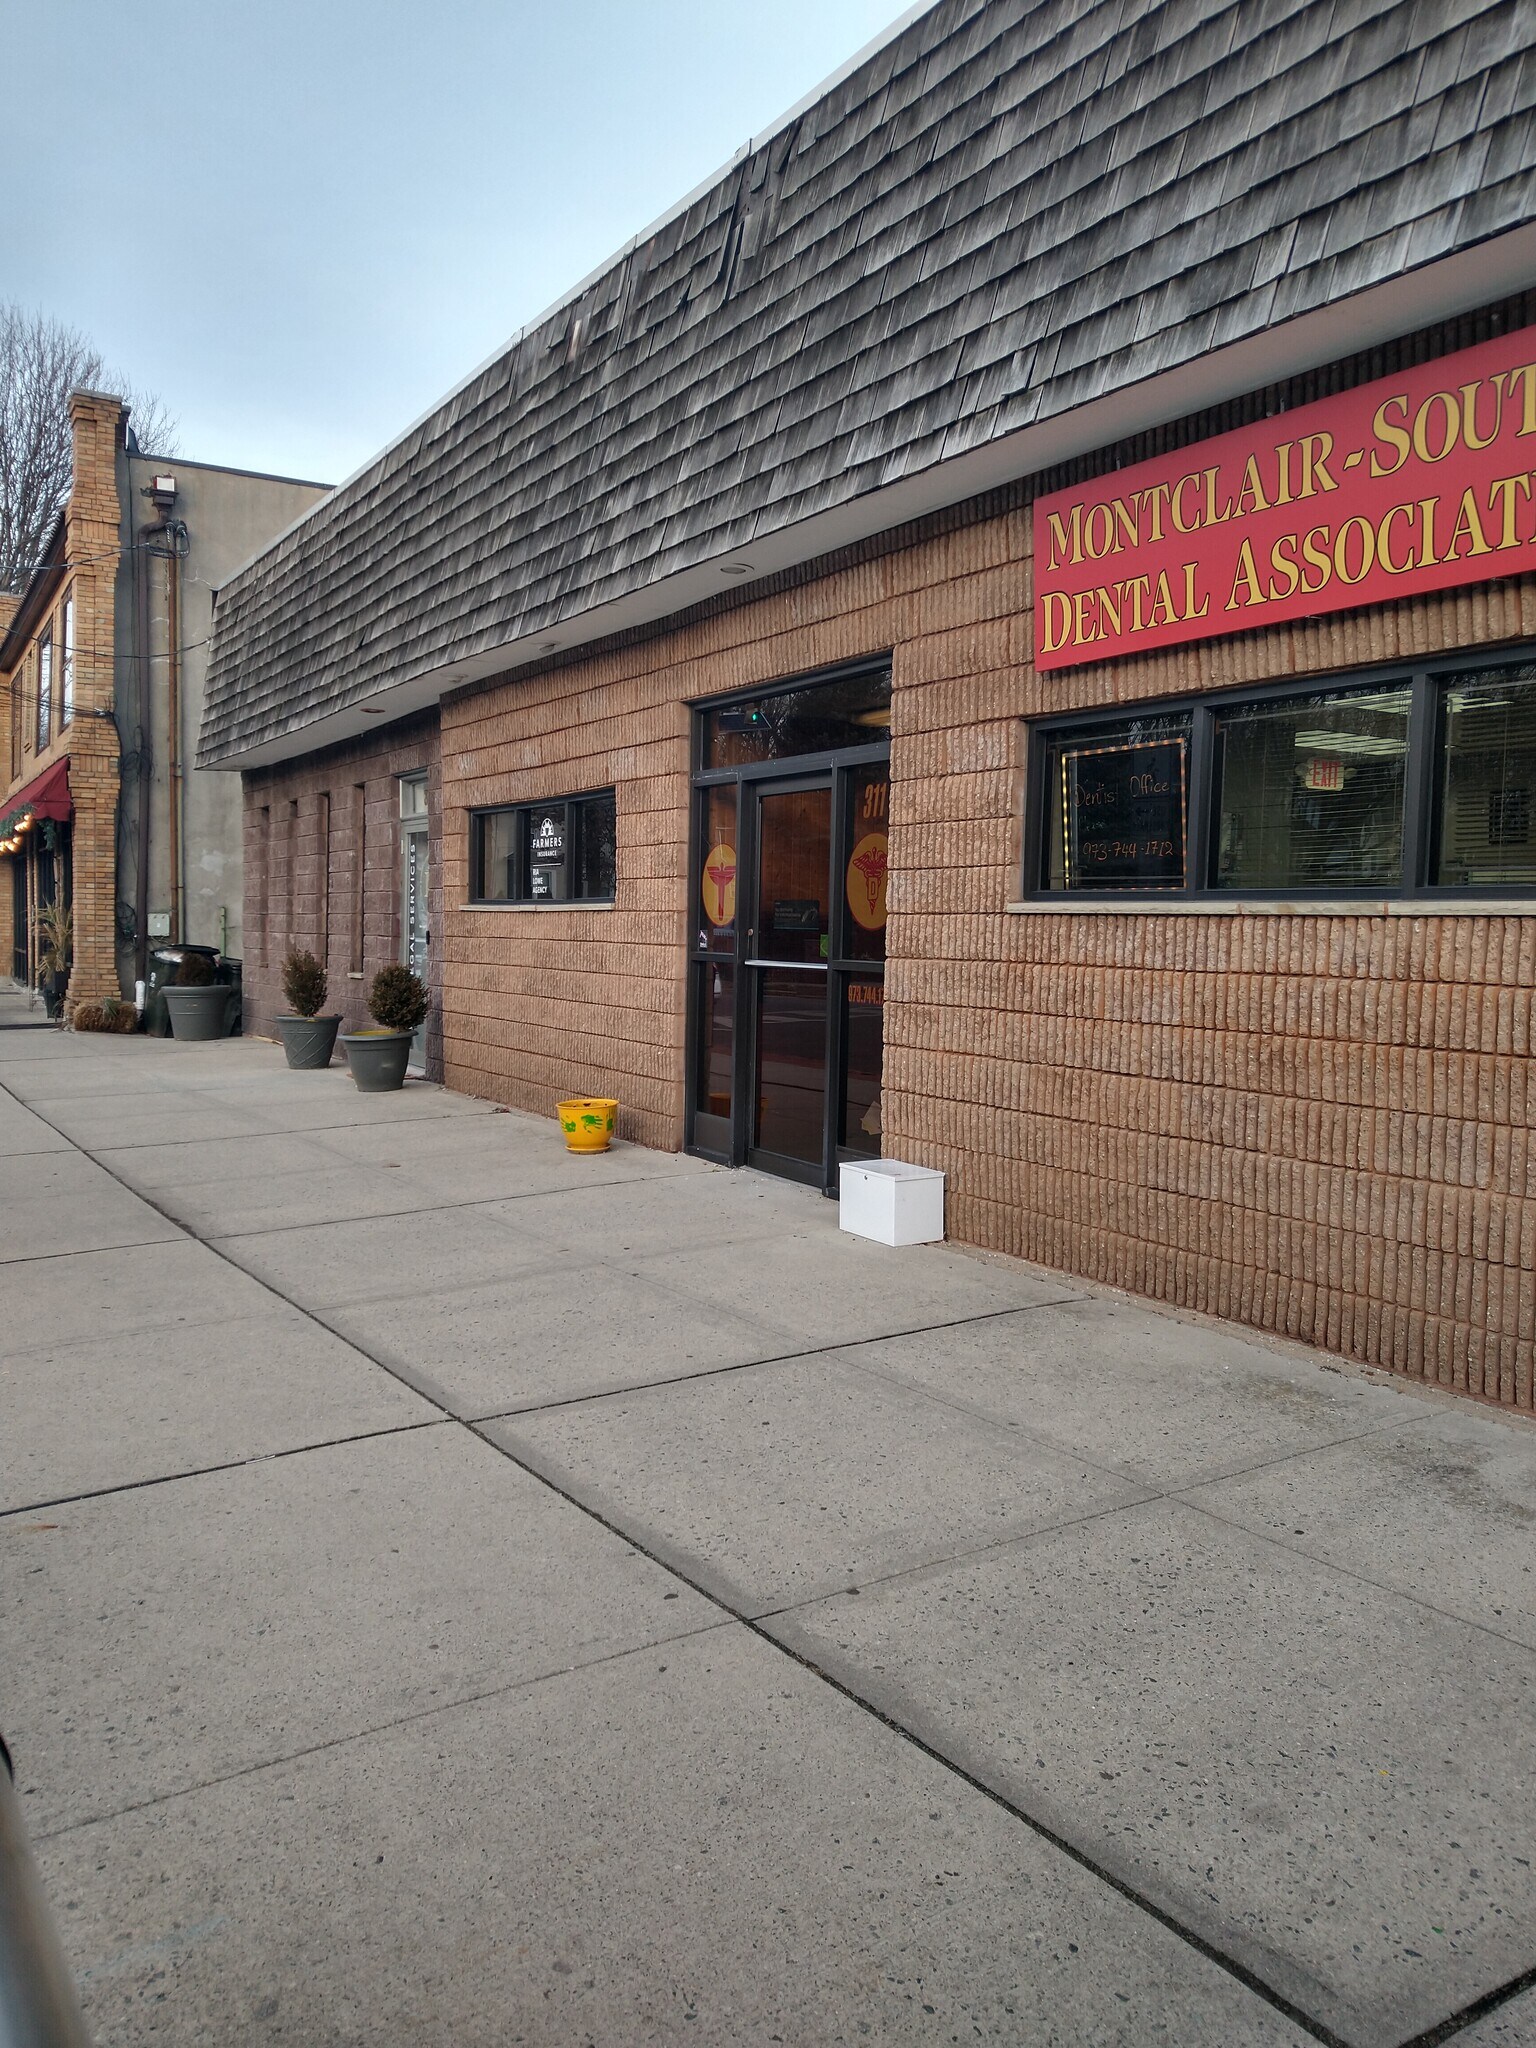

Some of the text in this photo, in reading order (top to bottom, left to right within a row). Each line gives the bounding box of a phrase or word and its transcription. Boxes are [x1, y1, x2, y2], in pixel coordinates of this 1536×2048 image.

[1041, 471, 1536, 654] DENTAL ASSOCIAT
[1312, 759, 1343, 788] EXIT
[1130, 774, 1169, 797] Office
[863, 783, 887, 818] 311
[532, 837, 562, 849] FARMERS
[532, 886, 547, 894] AGENCY
[848, 984, 884, 1005] 973.744.1
